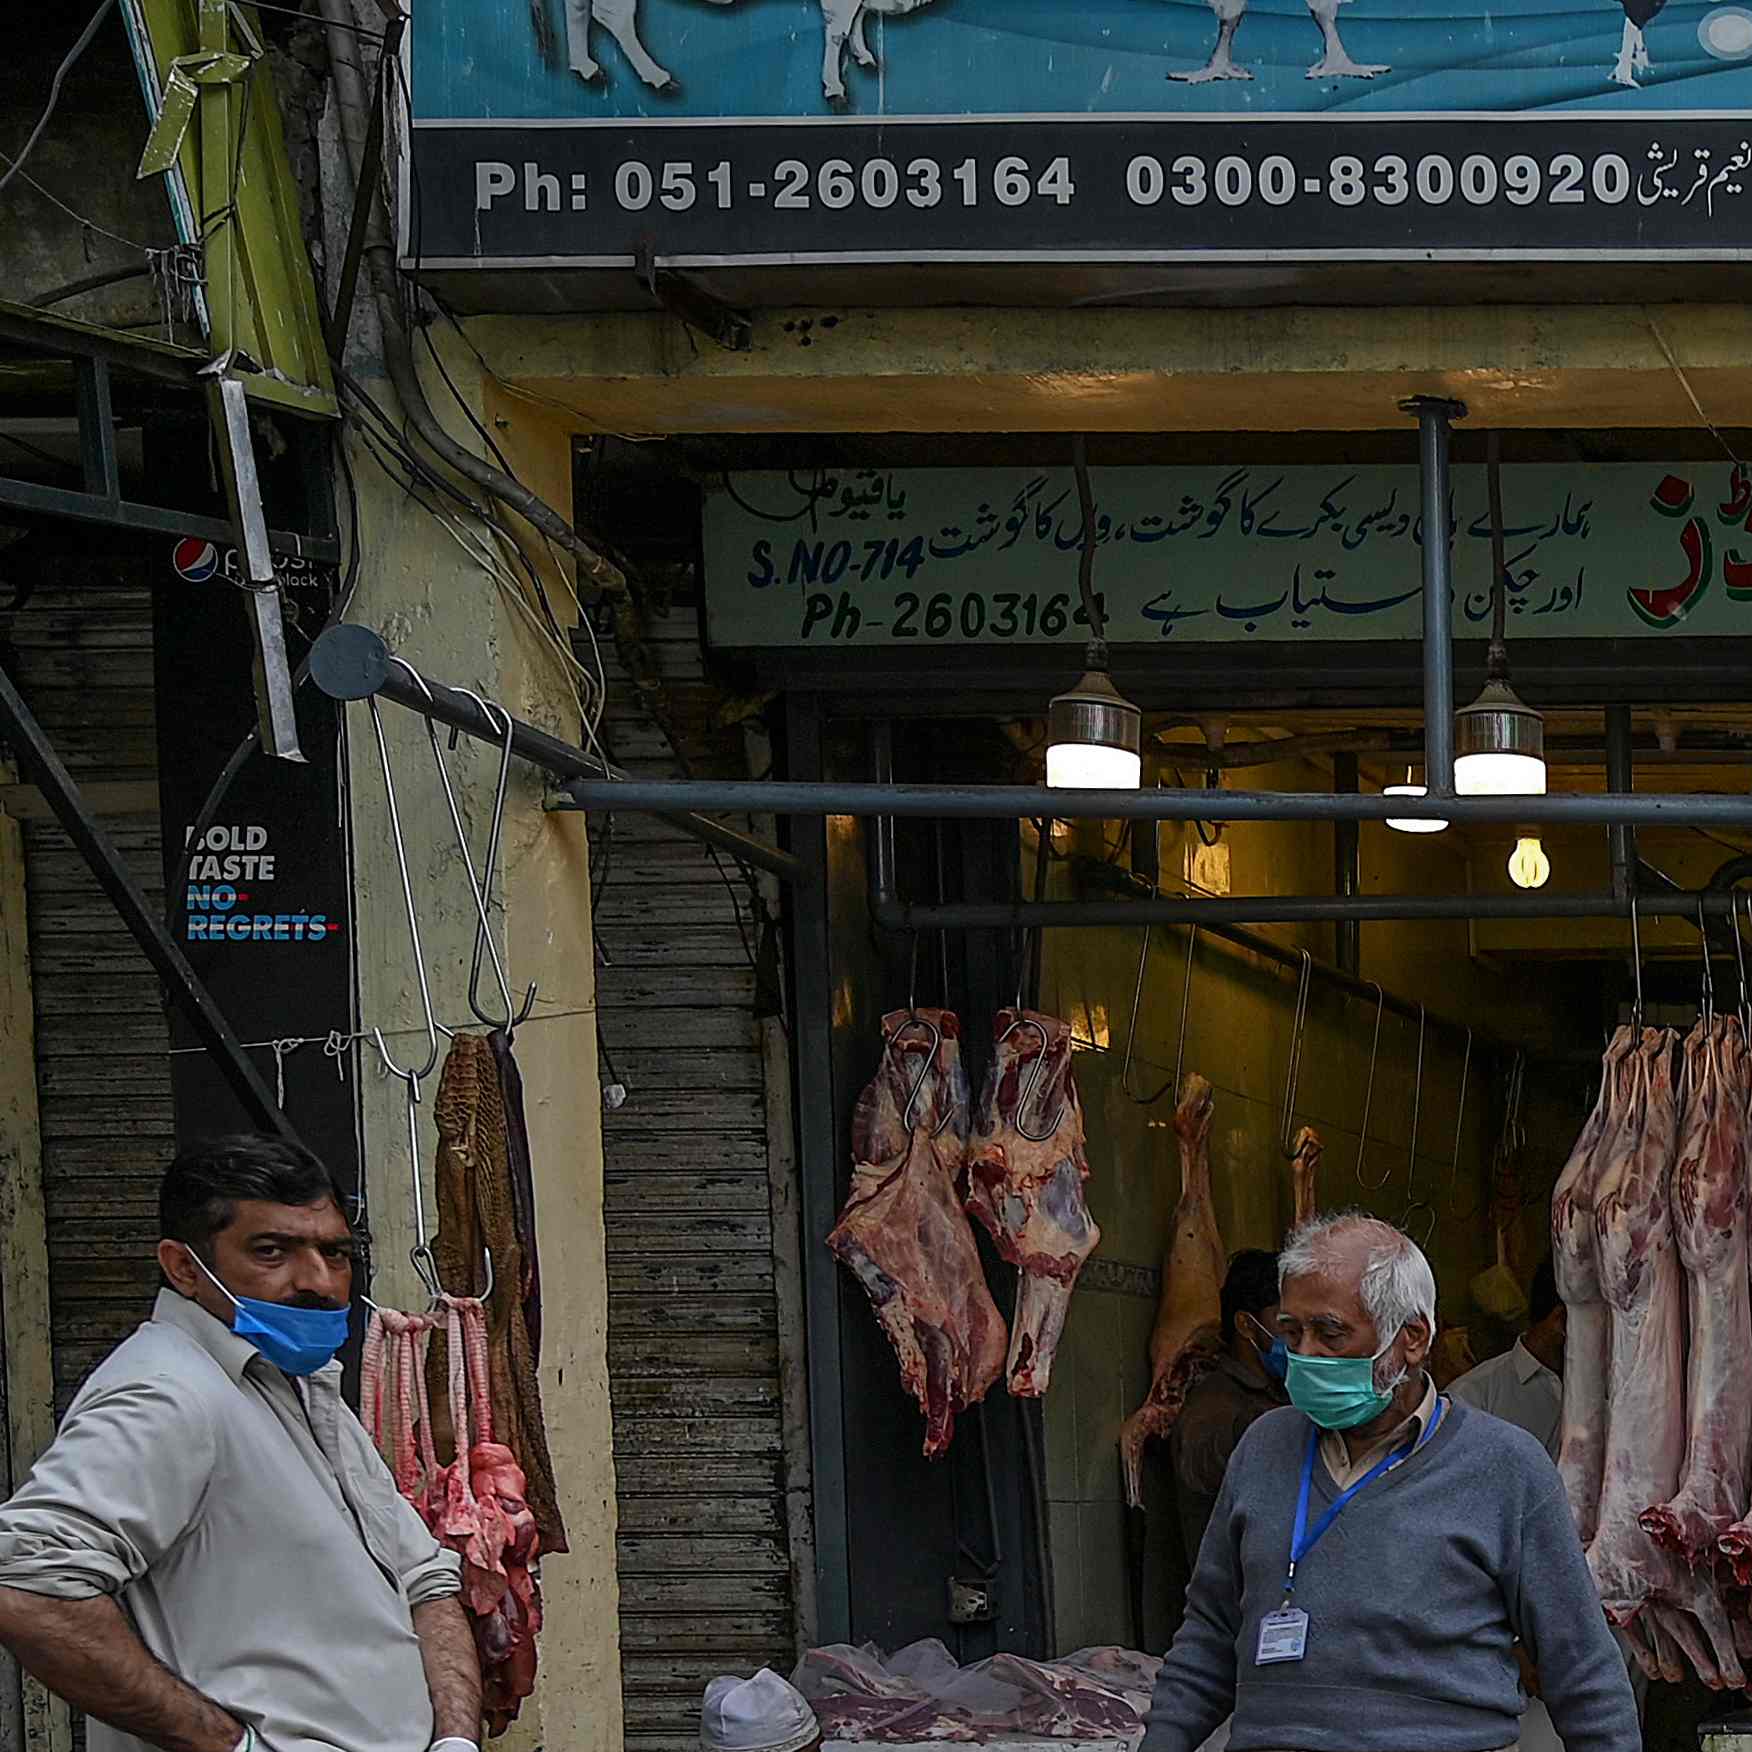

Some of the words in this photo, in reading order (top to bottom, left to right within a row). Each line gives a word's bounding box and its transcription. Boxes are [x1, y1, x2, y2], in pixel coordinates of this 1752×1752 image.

[474, 161, 587, 212] Ph:
[613, 156, 1077, 212] 051-2603164
[1124, 152, 1631, 206] 0300-8300920
[186, 884, 238, 911] NO
[186, 914, 327, 941] REGRETS
